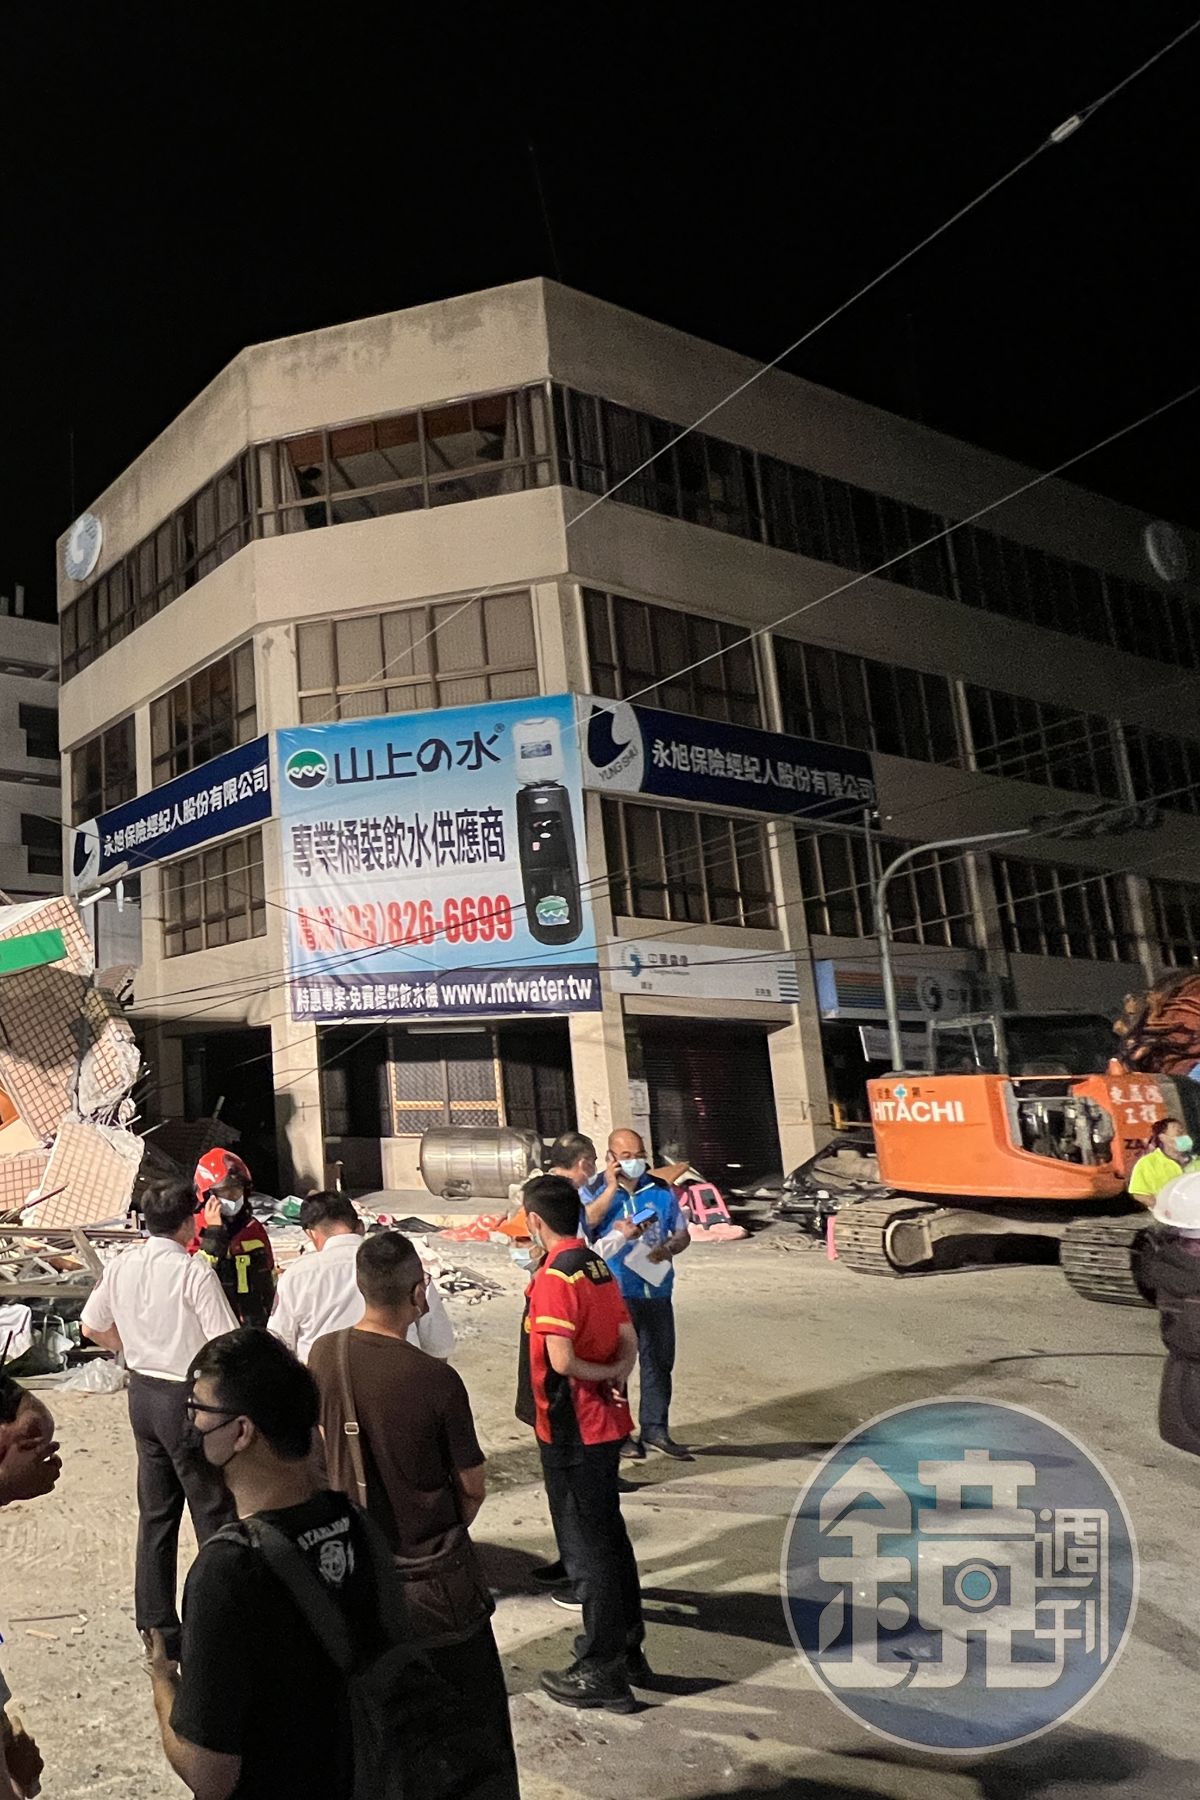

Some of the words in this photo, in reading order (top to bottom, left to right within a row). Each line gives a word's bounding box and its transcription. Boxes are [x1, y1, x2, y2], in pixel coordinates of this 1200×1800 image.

[333, 730, 502, 785] 山上の水
[652, 739, 874, 801] 永旭保險經紀人股份有限公司
[103, 764, 268, 857] 永旭保險經紀人股份有限公司
[291, 806, 505, 877] 專業桶裝飲水供應商
[441, 974, 593, 1006] www.mtwater.tw
[872, 1100, 966, 1123] HITACHI
